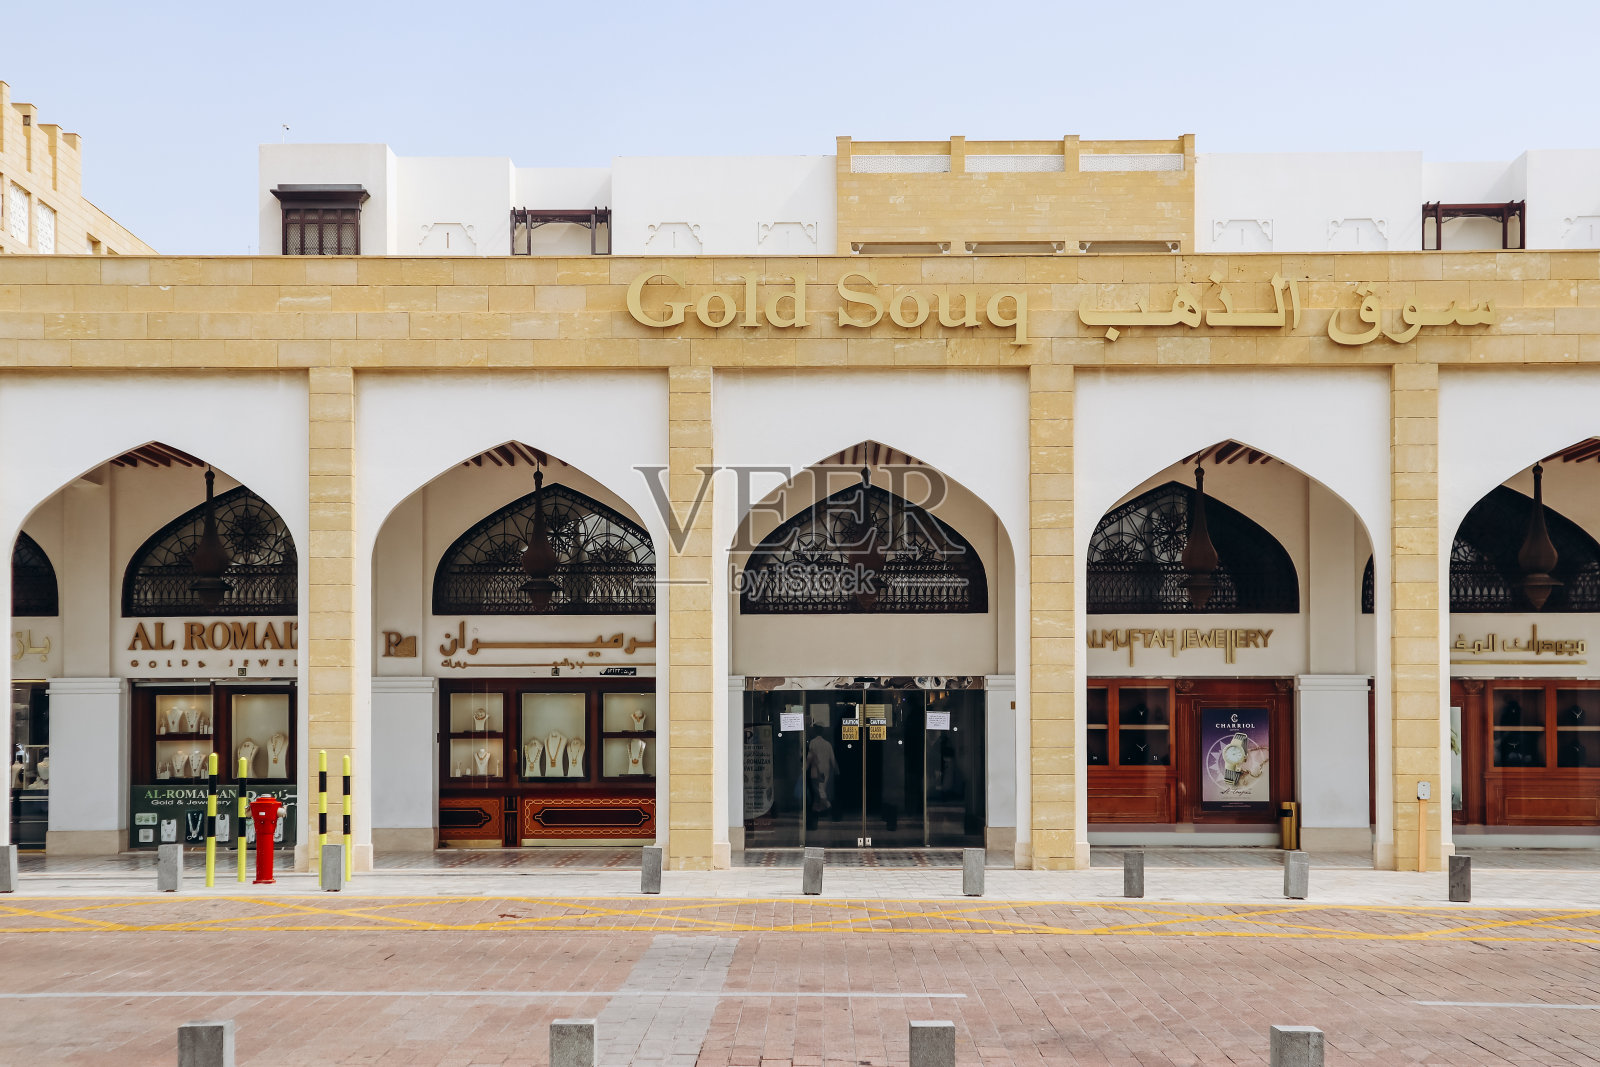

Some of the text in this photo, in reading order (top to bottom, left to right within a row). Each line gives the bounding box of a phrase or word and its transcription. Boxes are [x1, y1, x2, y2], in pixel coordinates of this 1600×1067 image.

[626, 270, 1033, 346] Gold Souq
[1078, 270, 1497, 346] سوق الذهب
[127, 621, 298, 651] AL ROMAI
